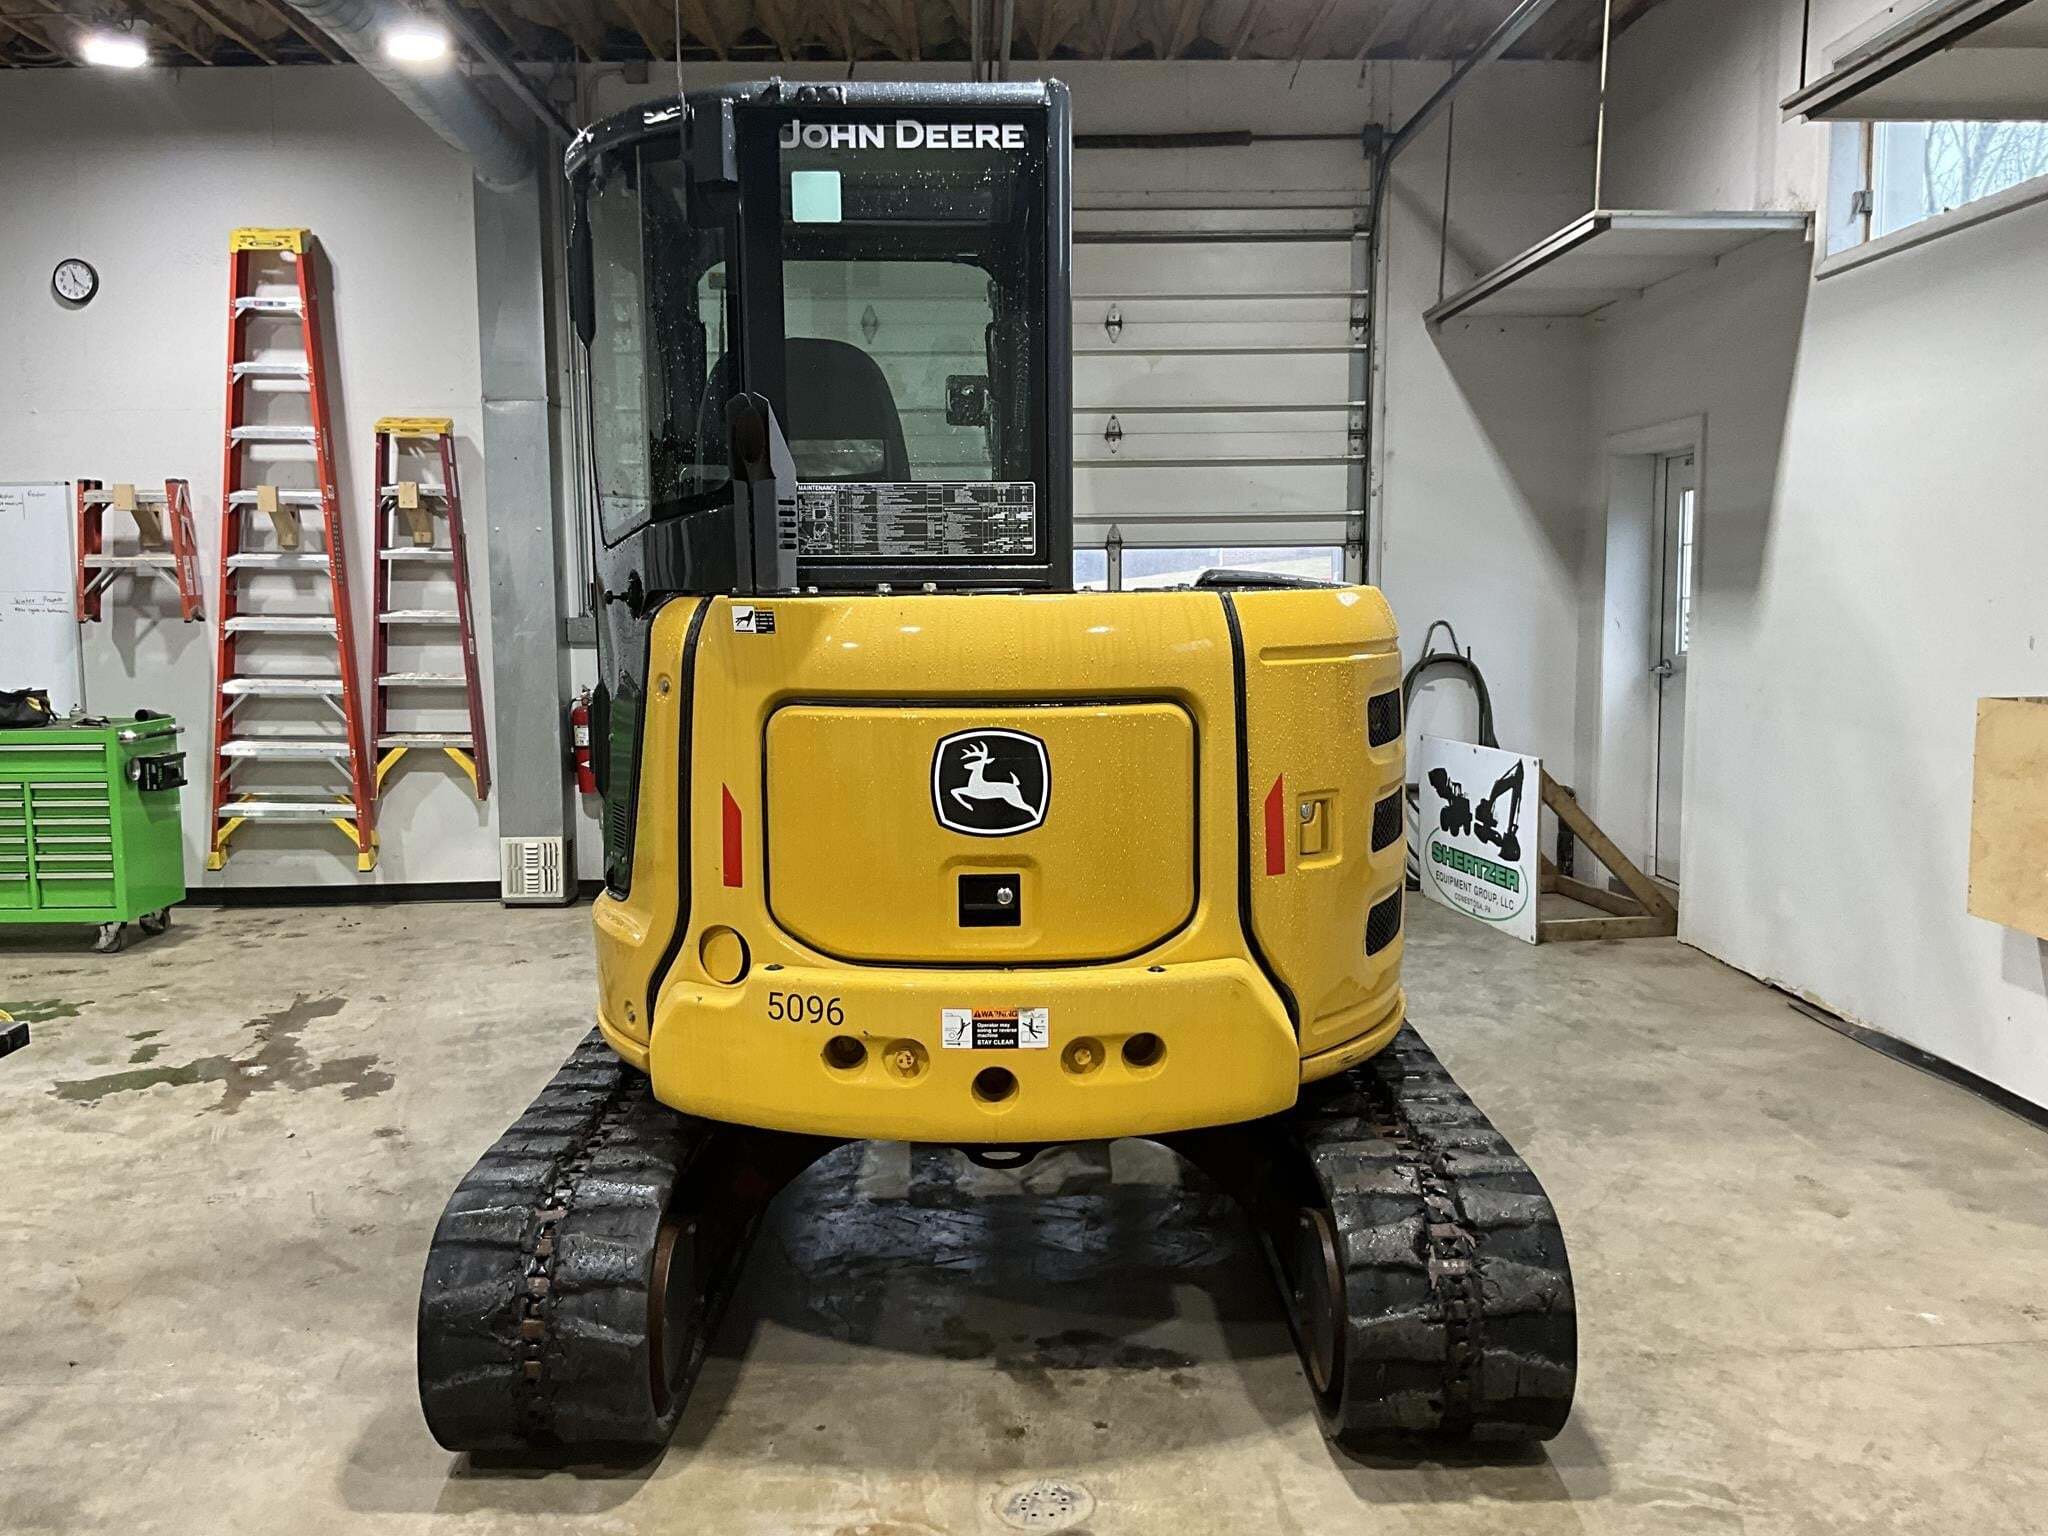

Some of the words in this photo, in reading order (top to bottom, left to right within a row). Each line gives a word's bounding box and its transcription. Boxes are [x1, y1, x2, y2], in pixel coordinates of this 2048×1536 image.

[780, 119, 885, 149] JOHN
[896, 119, 1025, 150] DEERE
[1432, 841, 1519, 893] SHERTZER
[1436, 870, 1472, 892] EQUIPMENT
[1473, 885, 1498, 905] GROUP,
[1500, 896, 1514, 910] LLC
[768, 992, 844, 1026] 5096
